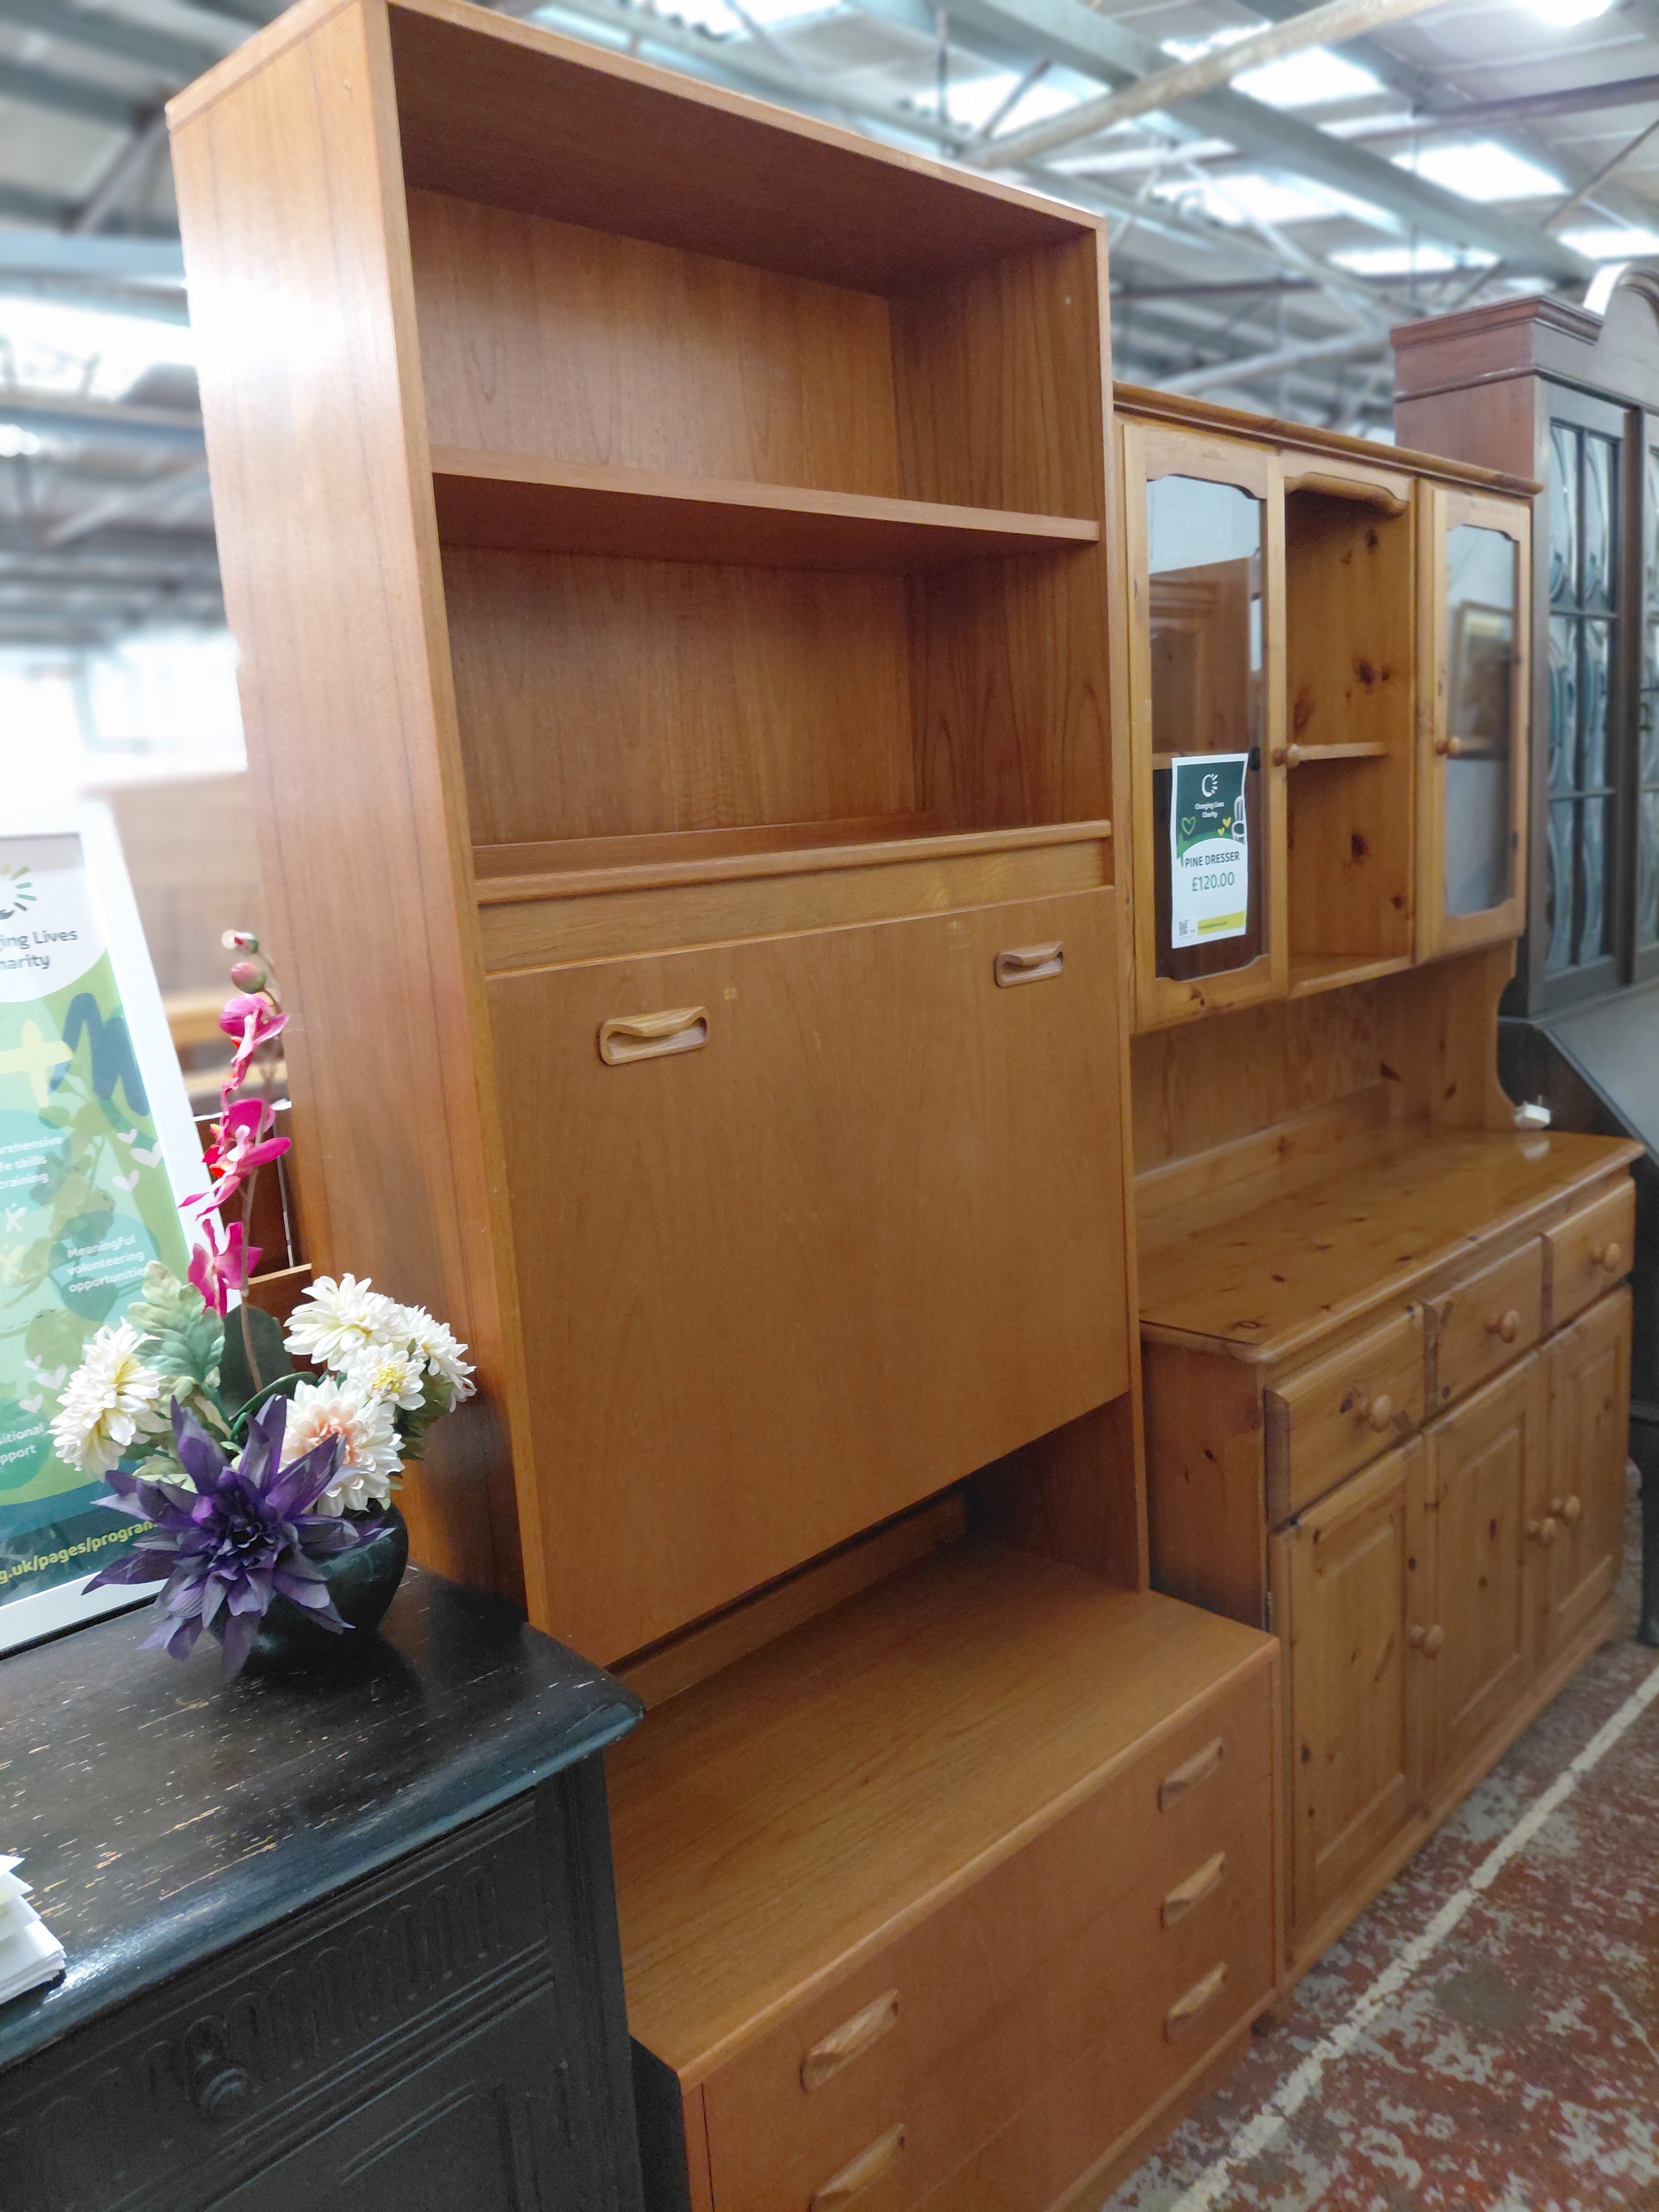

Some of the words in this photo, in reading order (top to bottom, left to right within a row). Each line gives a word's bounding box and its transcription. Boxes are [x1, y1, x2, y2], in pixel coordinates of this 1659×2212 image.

[1185, 856, 1203, 868] PINE
[1205, 851, 1240, 866] DRESSER
[1192, 871, 1235, 892] £120.00
[32, 930, 78, 944] Lives
[67, 1234, 136, 1258] Meaningful
[66, 1251, 145, 1276] volunteering
